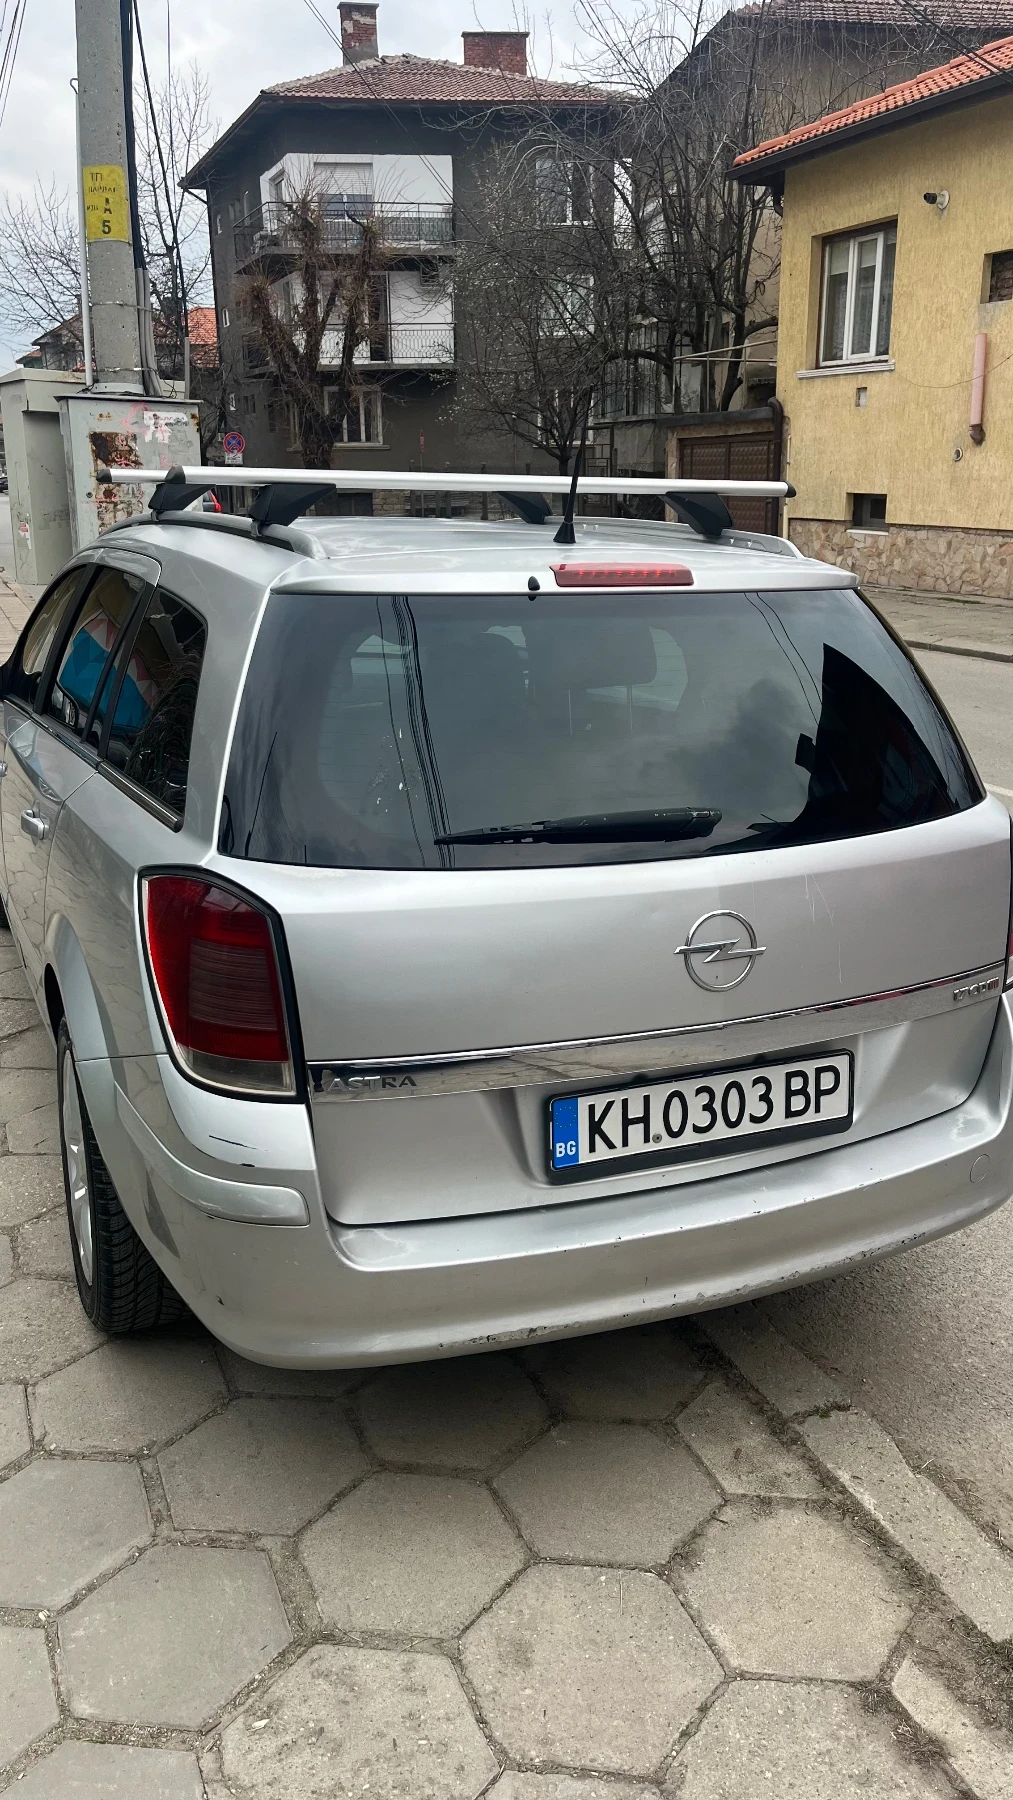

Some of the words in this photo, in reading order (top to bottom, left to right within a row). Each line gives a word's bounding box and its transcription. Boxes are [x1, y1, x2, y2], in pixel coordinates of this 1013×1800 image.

[101, 219, 112, 235] 5
[327, 1075, 418, 1092] ASTRA
[555, 1140, 577, 1158] BG
